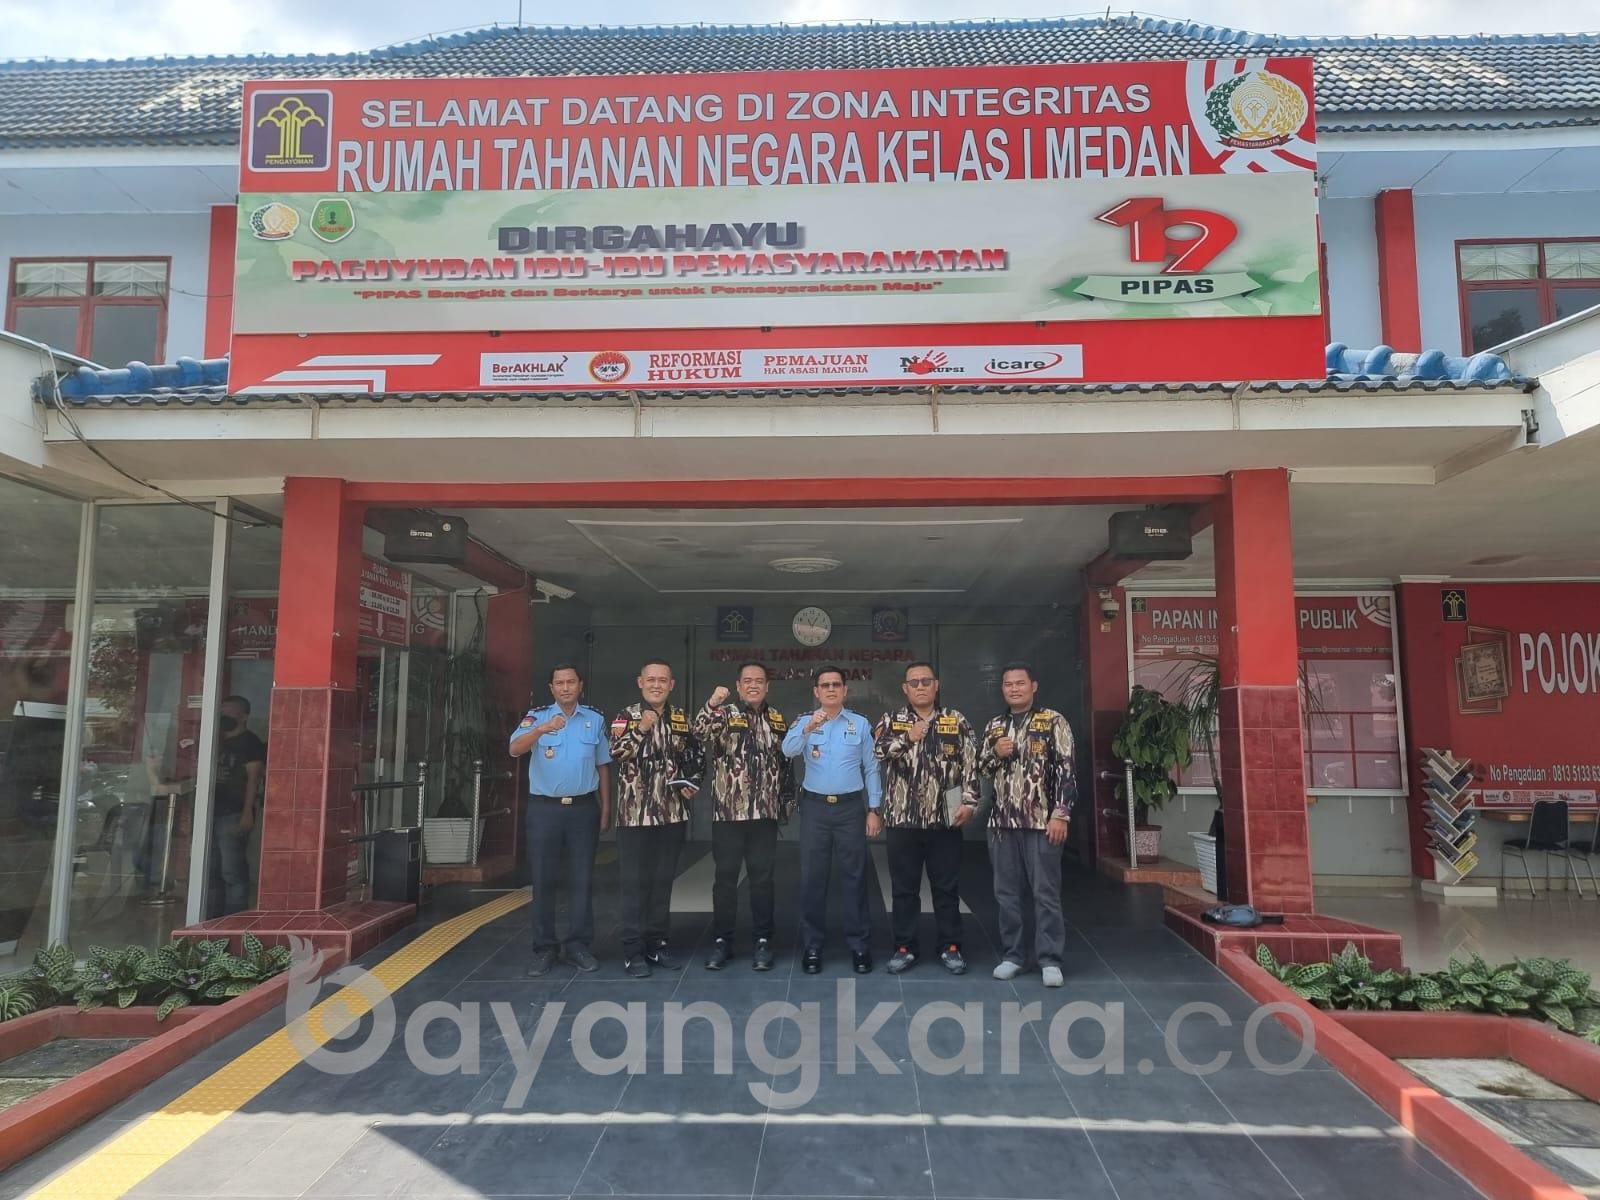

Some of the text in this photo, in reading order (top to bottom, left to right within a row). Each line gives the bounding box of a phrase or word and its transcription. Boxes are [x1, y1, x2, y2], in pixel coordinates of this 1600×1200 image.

[361, 84, 1150, 128] SELAMAT DATANG DI ZONA INTEGRITAS
[337, 124, 1190, 192] RUMAH TAHANAN NEGARA KELAS I MEDAN
[498, 222, 799, 250] DIRGAHAYU
[1094, 197, 1238, 274] 19
[292, 249, 1005, 281] PAGUYUBAN IBU-IBU PEMASYARAKATAN
[428, 288, 507, 300] Bangkit
[511, 288, 548, 297] dan
[553, 287, 643, 298] Berkarya
[648, 286, 705, 296] untuk
[711, 284, 877, 295] Pemasyarakatan
[1121, 279, 1214, 295] PIPAS
[492, 363, 564, 373] BerAKHLAK
[649, 351, 742, 368] REFORMASI
[763, 354, 869, 366] PEMAJUAN
[991, 358, 1046, 370] icare
[648, 367, 742, 381] HUKUM
[764, 367, 785, 375] HAK
[822, 366, 869, 374] MANUSIA
[1152, 609, 1203, 629] PAPAN
[1300, 609, 1358, 629] PUBLIK
[1519, 632, 1600, 694] POJOK
[1490, 765, 1501, 781] No
[1503, 765, 1546, 785] Pengaduan
[1552, 765, 1571, 782] 0813
